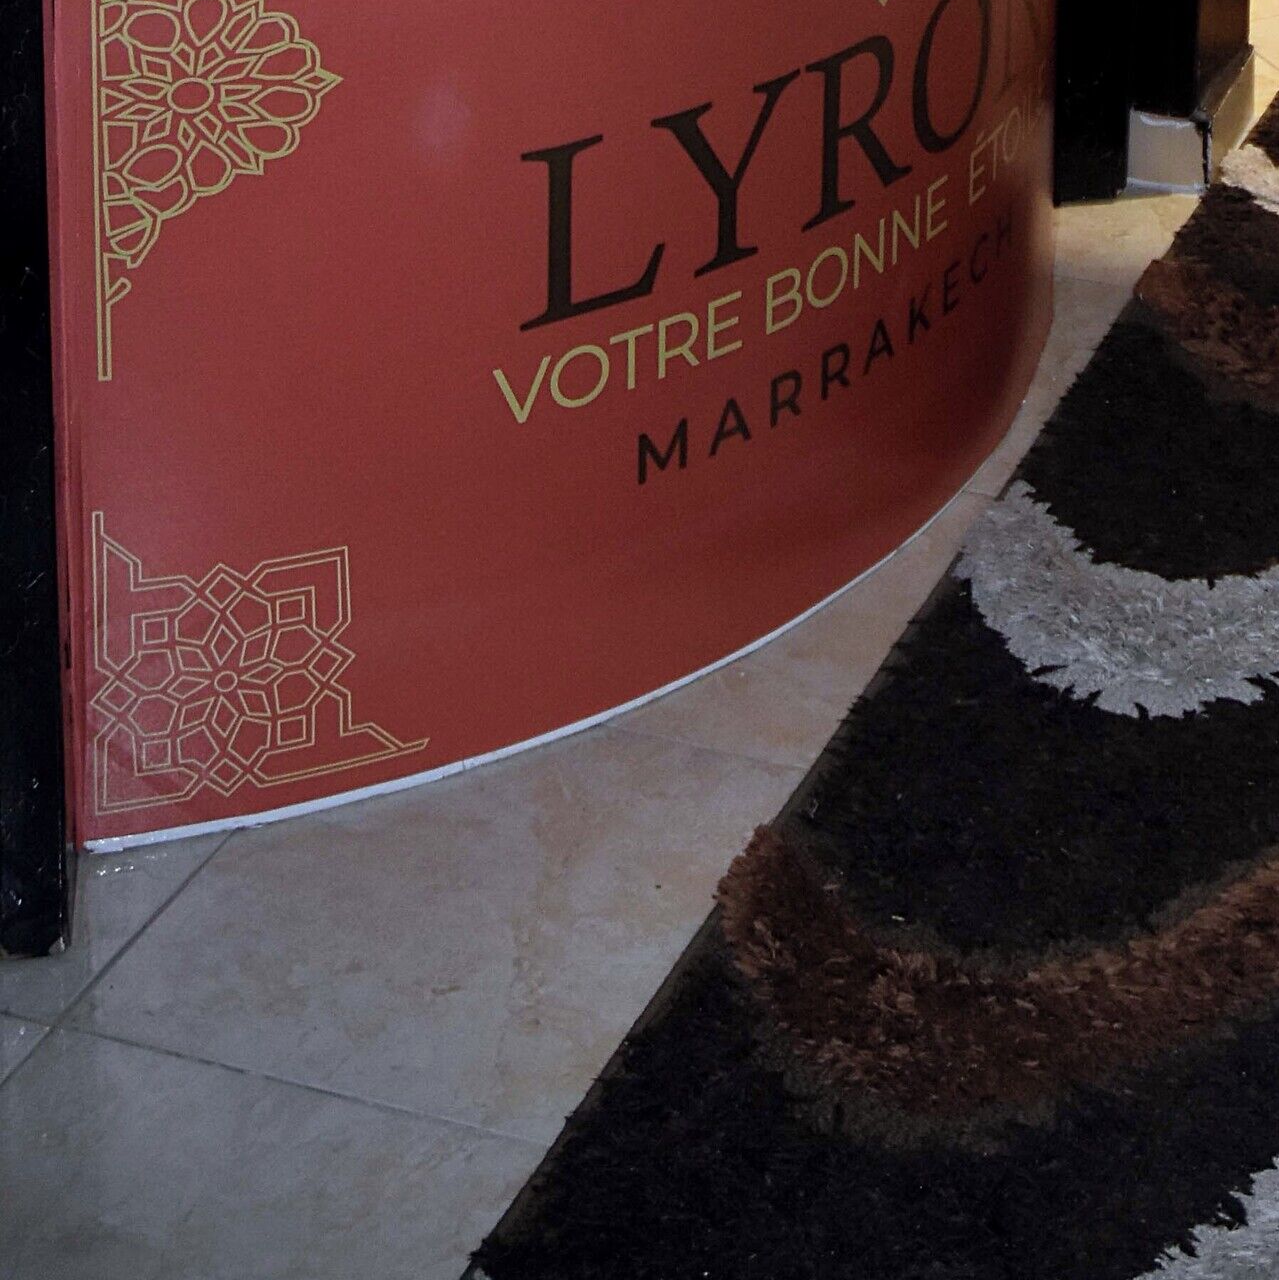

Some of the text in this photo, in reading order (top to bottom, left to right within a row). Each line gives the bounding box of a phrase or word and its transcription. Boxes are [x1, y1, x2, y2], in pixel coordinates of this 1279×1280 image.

[493, 291, 744, 424] VOTRE
[766, 175, 948, 334] BONNE
[638, 212, 1014, 484] MARRAKECH
